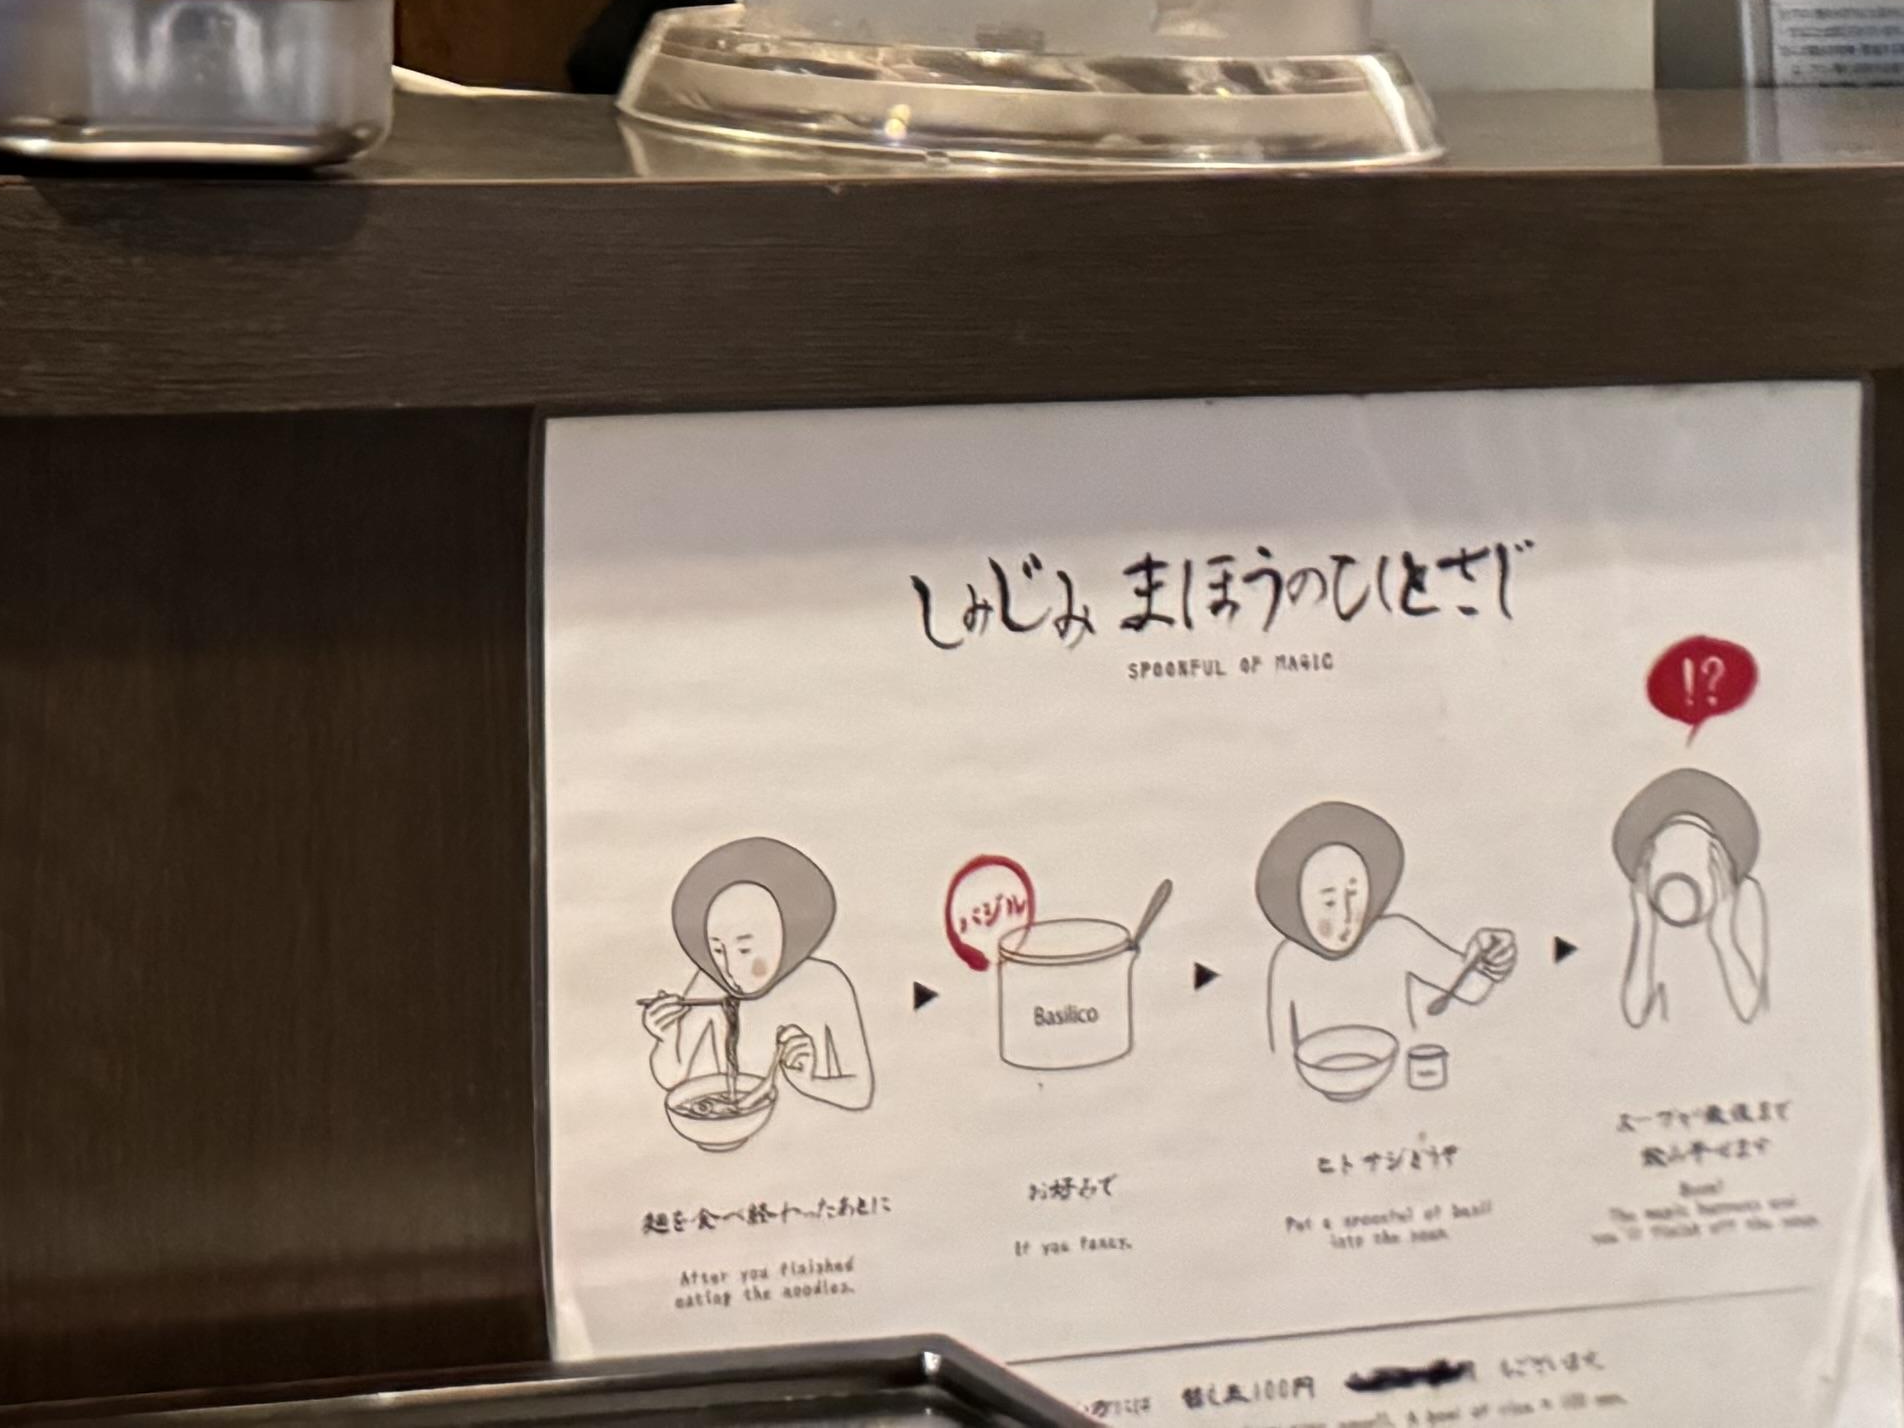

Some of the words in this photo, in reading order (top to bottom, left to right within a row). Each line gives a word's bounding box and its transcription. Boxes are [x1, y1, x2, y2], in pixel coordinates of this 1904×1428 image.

[1127, 658, 1227, 680] SPOONFUL
[1239, 655, 1262, 675] OF
[1274, 652, 1335, 673] MAGIC
[1033, 1004, 1100, 1027] Basilico
[678, 1269, 730, 1288] After
[739, 1266, 770, 1284] you
